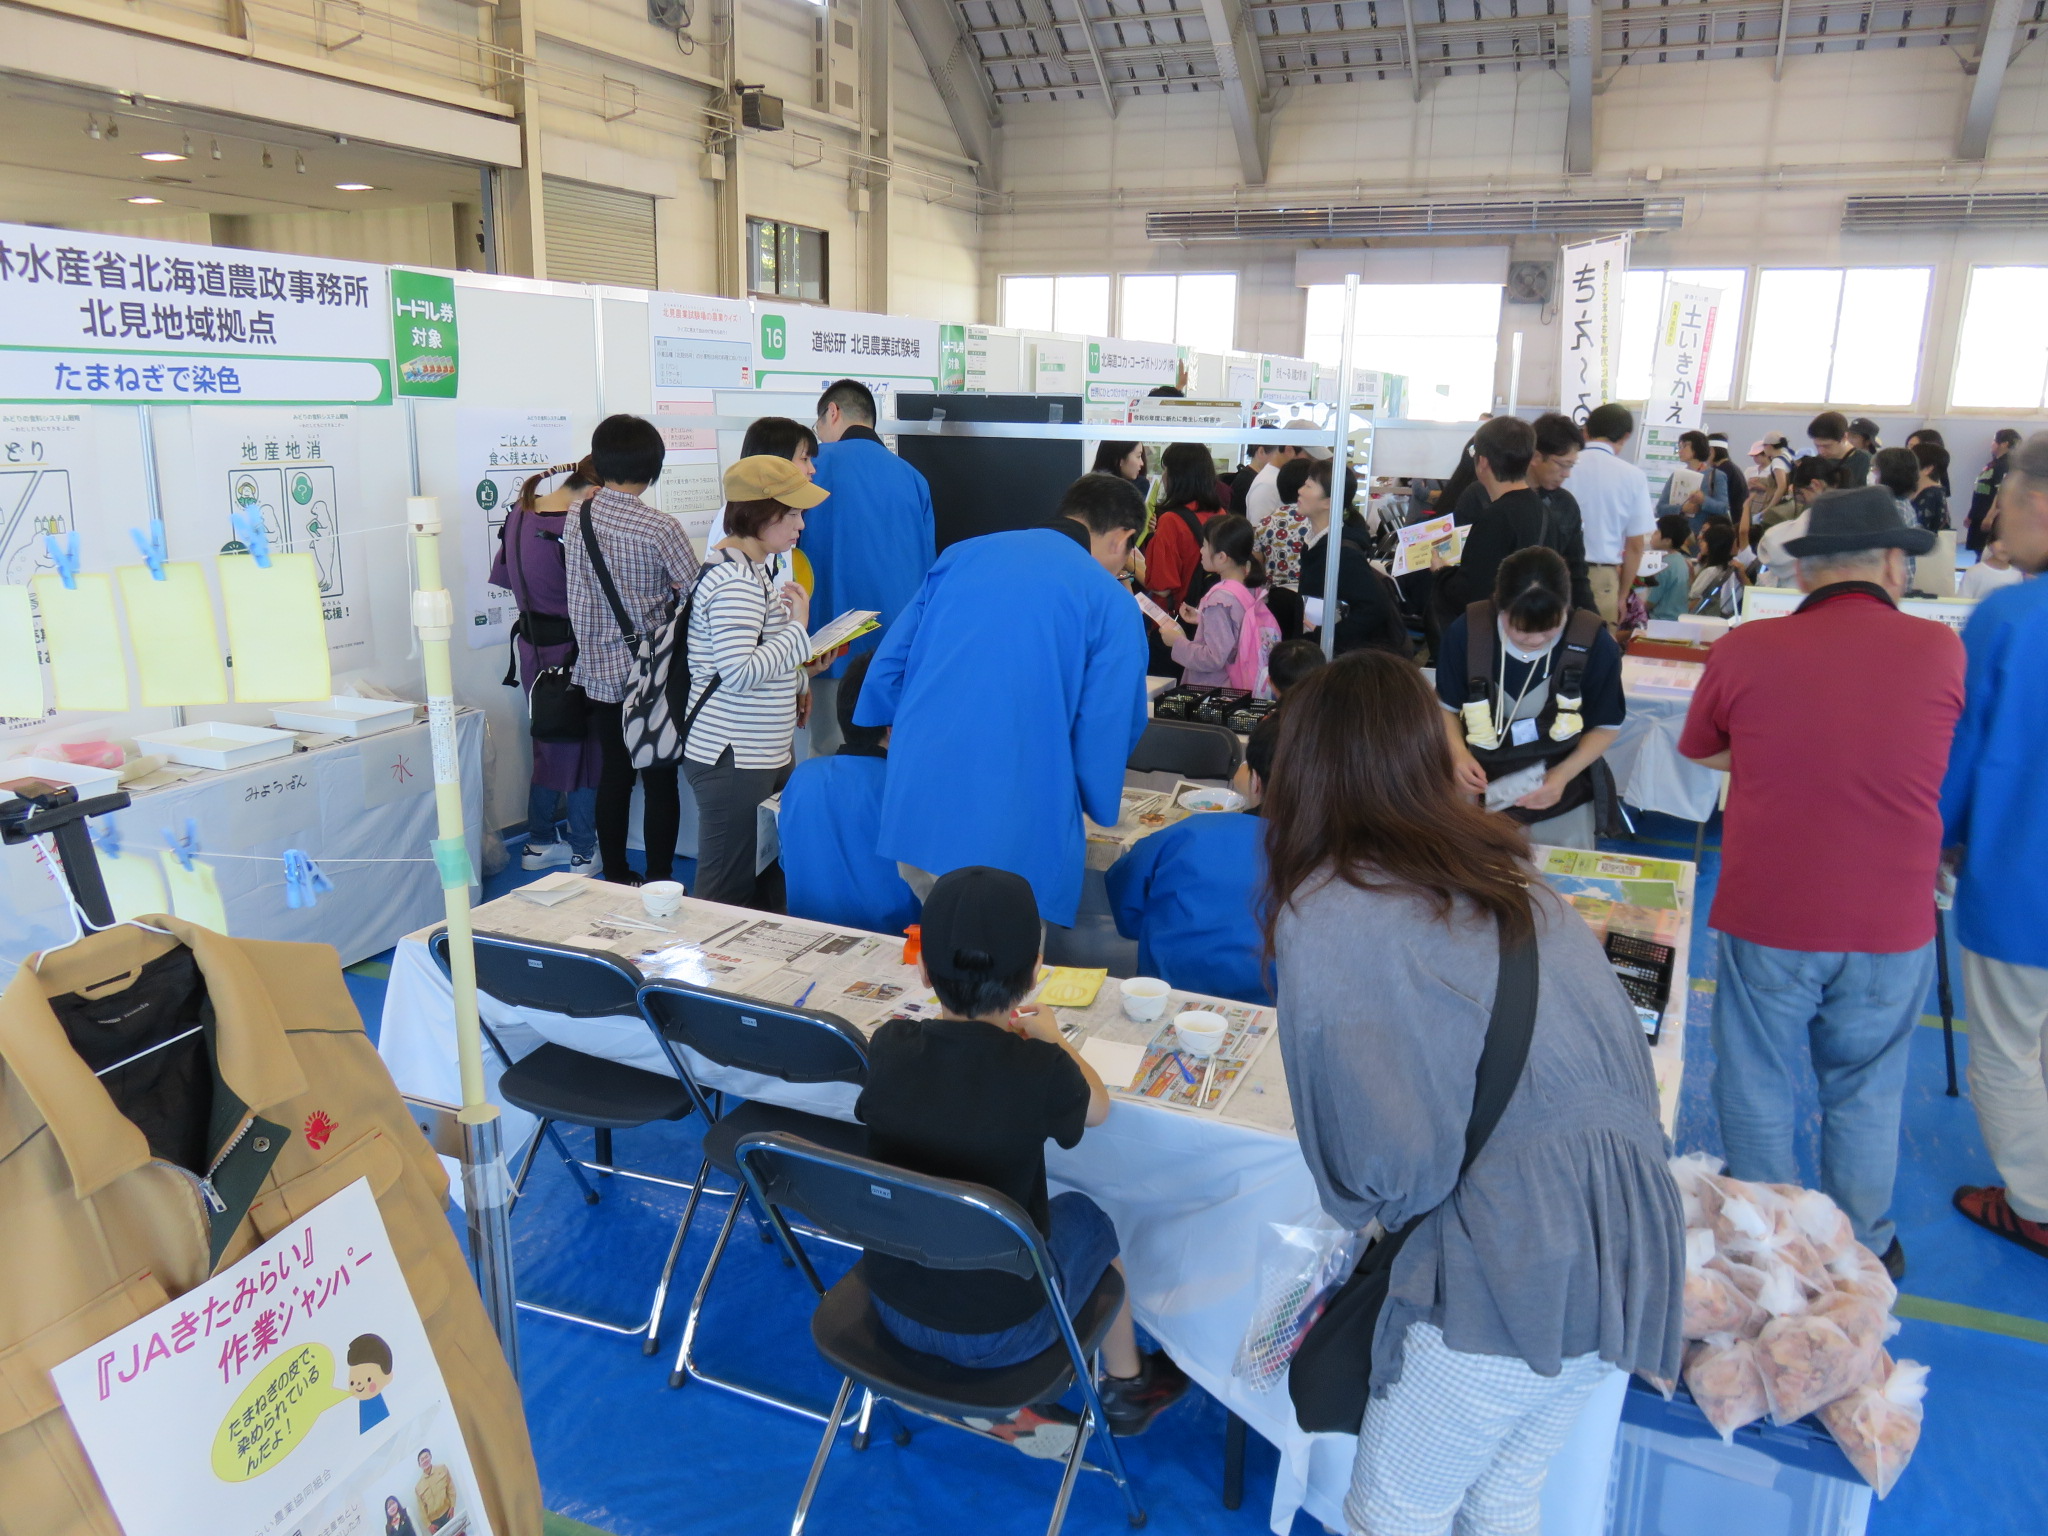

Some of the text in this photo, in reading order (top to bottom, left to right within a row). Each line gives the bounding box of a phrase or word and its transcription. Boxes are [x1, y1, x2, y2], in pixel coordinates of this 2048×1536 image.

[80, 298, 277, 344] 北見地域拠点
[396, 297, 454, 322] トドル券
[412, 327, 443, 349] 対象
[766, 327, 783, 349] 16
[812, 331, 846, 354] 道総研
[851, 333, 920, 359] 北見農業試験場
[948, 357, 960, 370] 対象
[1090, 352, 1099, 366] 17
[55, 362, 242, 394] たまねぎで染色
[241, 440, 321, 461] 地産地消
[499, 434, 538, 448] ごはんを
[489, 451, 549, 466] 食べ残さない
[391, 754, 414, 784] 水
[98, 1227, 314, 1401] 『JAきたみらい』
[218, 1246, 372, 1384] 作業ジャンパー
[237, 1365, 319, 1458] 染められている
[247, 1418, 292, 1476] んだよ！
